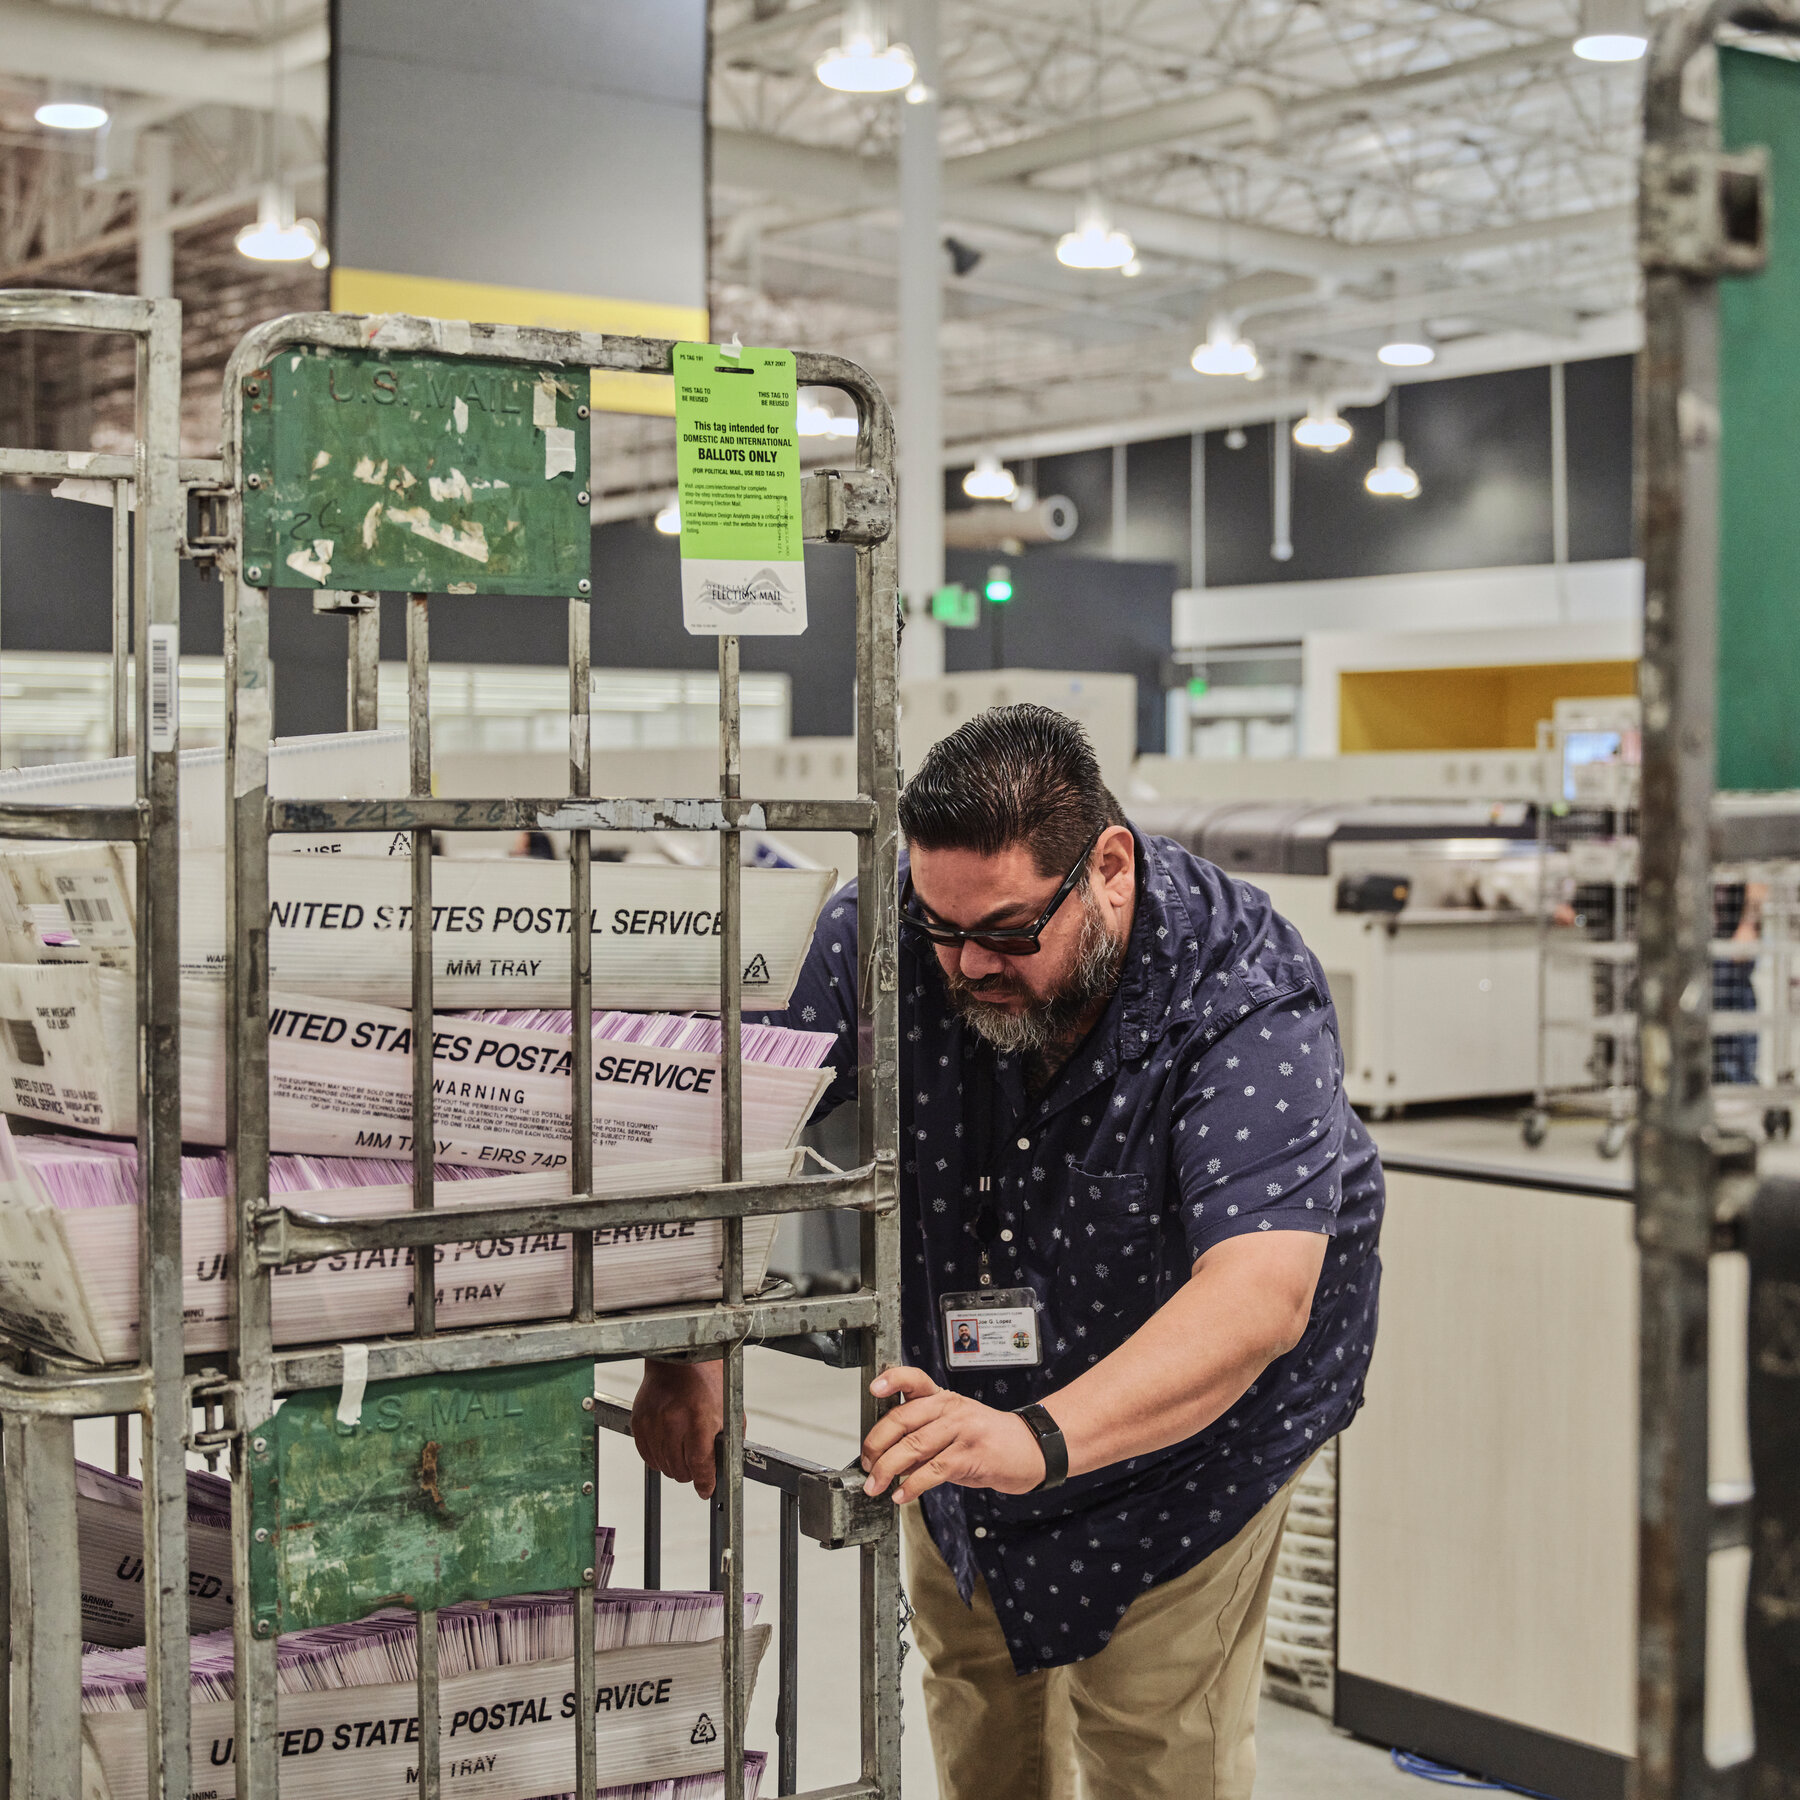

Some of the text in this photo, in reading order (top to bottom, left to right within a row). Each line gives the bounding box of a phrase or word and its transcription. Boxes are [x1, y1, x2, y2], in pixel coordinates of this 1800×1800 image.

[329, 366, 520, 414] U.S. MAIL
[694, 421, 779, 434] This tag intended for
[683, 434, 793, 447] DOMESTIC AND INTERNATIONAL
[698, 448, 778, 463] BALLOTS ONLY
[760, 591, 782, 601] MAIL
[269, 901, 365, 929] NITED
[373, 905, 485, 932] STTES
[492, 907, 602, 934] POSTL
[446, 960, 542, 976] MM TRAY
[36, 1007, 76, 1017] TARE WEIGHT
[269, 1008, 716, 1093] ITED STAES POSTA SERVICE
[11, 1077, 32, 1092] UNITED
[32, 1081, 56, 1096] STATES
[433, 1079, 525, 1104] WARNING
[16, 1093, 40, 1109] POSTAL
[38, 1098, 65, 1115] SERVICE
[288, 1077, 326, 1087] EQUIPMENT
[472, 1102, 508, 1111] PERMISSION
[541, 1111, 563, 1119] POSTAL
[627, 1121, 658, 1131] EQUIPMENT
[292, 1092, 332, 1103] ELECTRONIC
[368, 1103, 410, 1114] TECHNOLOGY
[464, 1115, 493, 1124] LOCATION
[601, 1132, 626, 1140] SUBJECT
[308, 1087, 338, 1096] PURPOSE
[339, 1091, 360, 1099] OTHER
[363, 1094, 380, 1102] THAN
[476, 1110, 504, 1118] STRICTLY
[505, 1114, 540, 1123] PROHIBITED
[355, 1130, 567, 1169] MM TY EIRS 74P
[593, 1221, 695, 1246] ERVICE
[453, 1284, 505, 1302] TRAY
[431, 1387, 524, 1428] MAIL
[211, 1679, 672, 1766] UED STATE POSTAL SRVICE
[450, 1754, 497, 1778] TRAY
